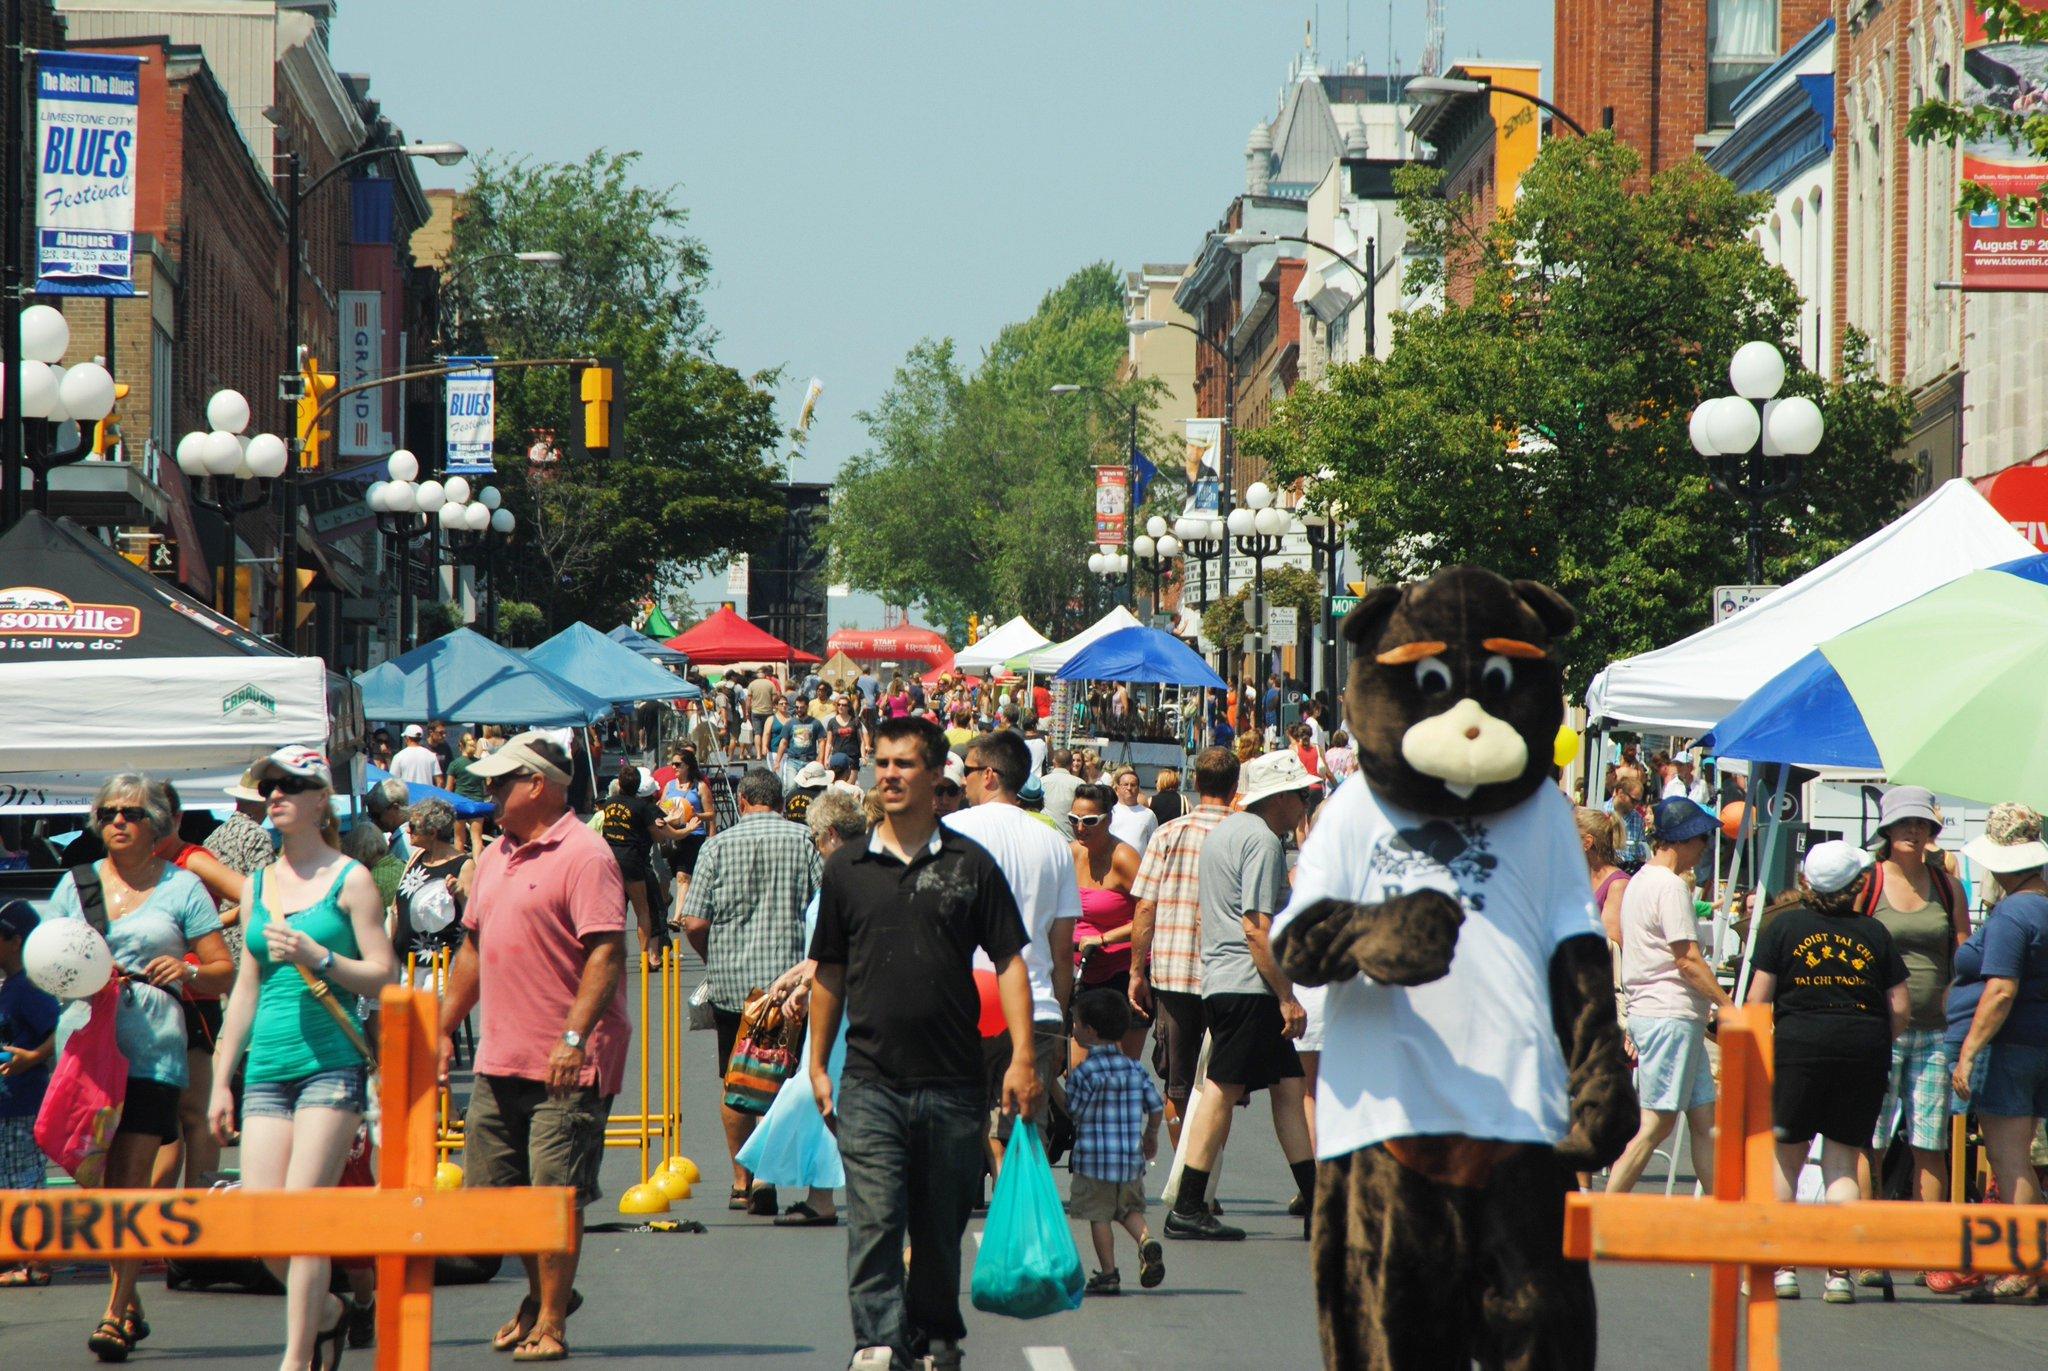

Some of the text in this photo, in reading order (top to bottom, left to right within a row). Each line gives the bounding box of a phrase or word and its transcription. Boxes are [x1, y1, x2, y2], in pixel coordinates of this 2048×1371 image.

[41, 72, 135, 96] The Best In The Blues
[40, 111, 134, 126] LIMESTONE CITY
[43, 126, 132, 178] BLUES
[44, 175, 129, 216] Festival
[56, 231, 115, 249] August
[1974, 240, 2018, 253] August
[2020, 240, 2036, 251] 5th
[83, 251, 97, 260] 25
[100, 251, 108, 261] &
[112, 252, 126, 261] 26
[355, 331, 369, 419] GRAND
[449, 393, 491, 416] BLUES
[10, 639, 25, 649] is
[29, 638, 53, 649] all
[57, 641, 85, 649] we
[873, 639, 897, 647] START
[1793, 933, 1828, 957] TAOIST
[1834, 935, 1852, 947] TAI
[1794, 977, 1811, 985] TAI
[1813, 977, 1832, 985] CHI
[0, 1197, 202, 1251] ORKS
[1962, 1215, 2048, 1273] PU
